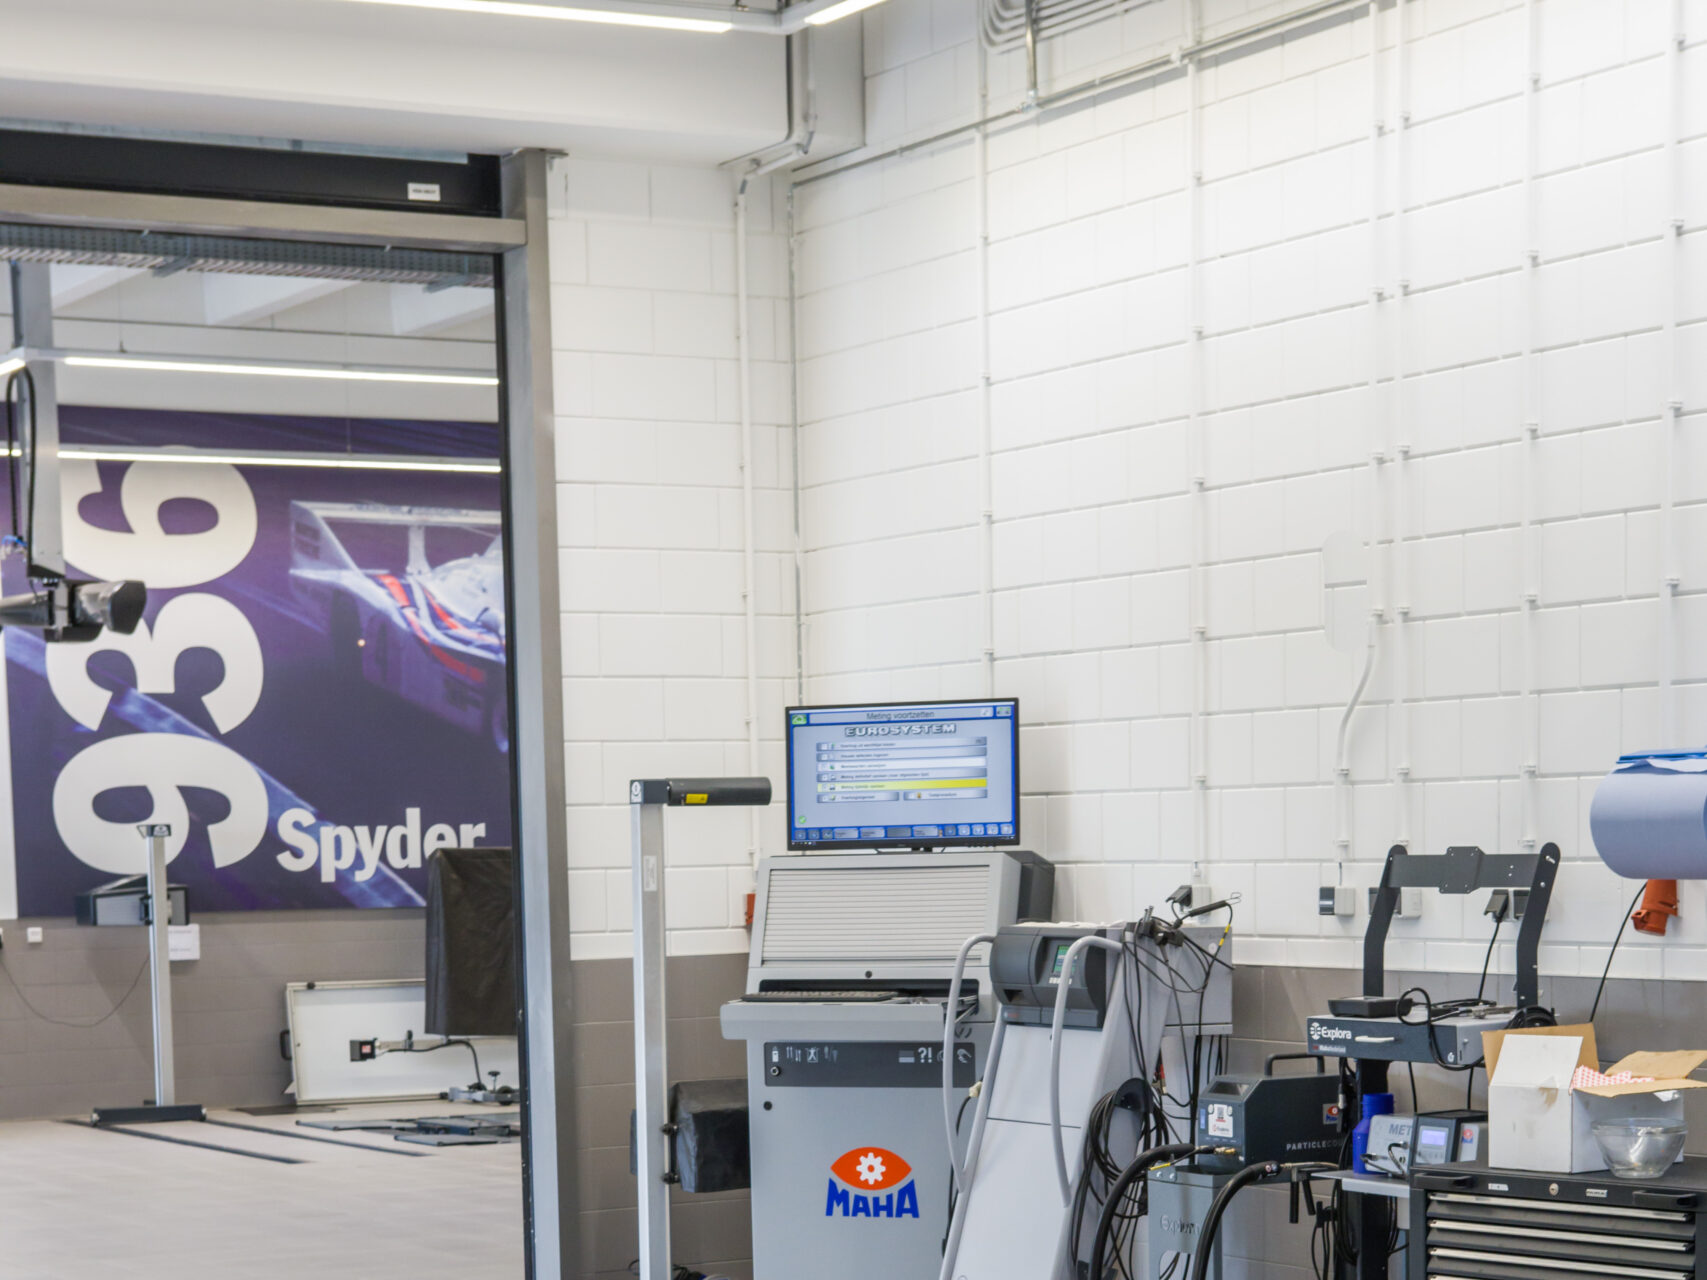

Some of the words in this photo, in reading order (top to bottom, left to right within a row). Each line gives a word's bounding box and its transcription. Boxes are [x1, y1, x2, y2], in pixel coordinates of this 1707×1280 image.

[866, 712, 892, 722] Meting
[844, 723, 957, 738] EUROSYSTEM
[1321, 1026, 1352, 1041] Explora
[825, 1177, 920, 1219] MAHA
